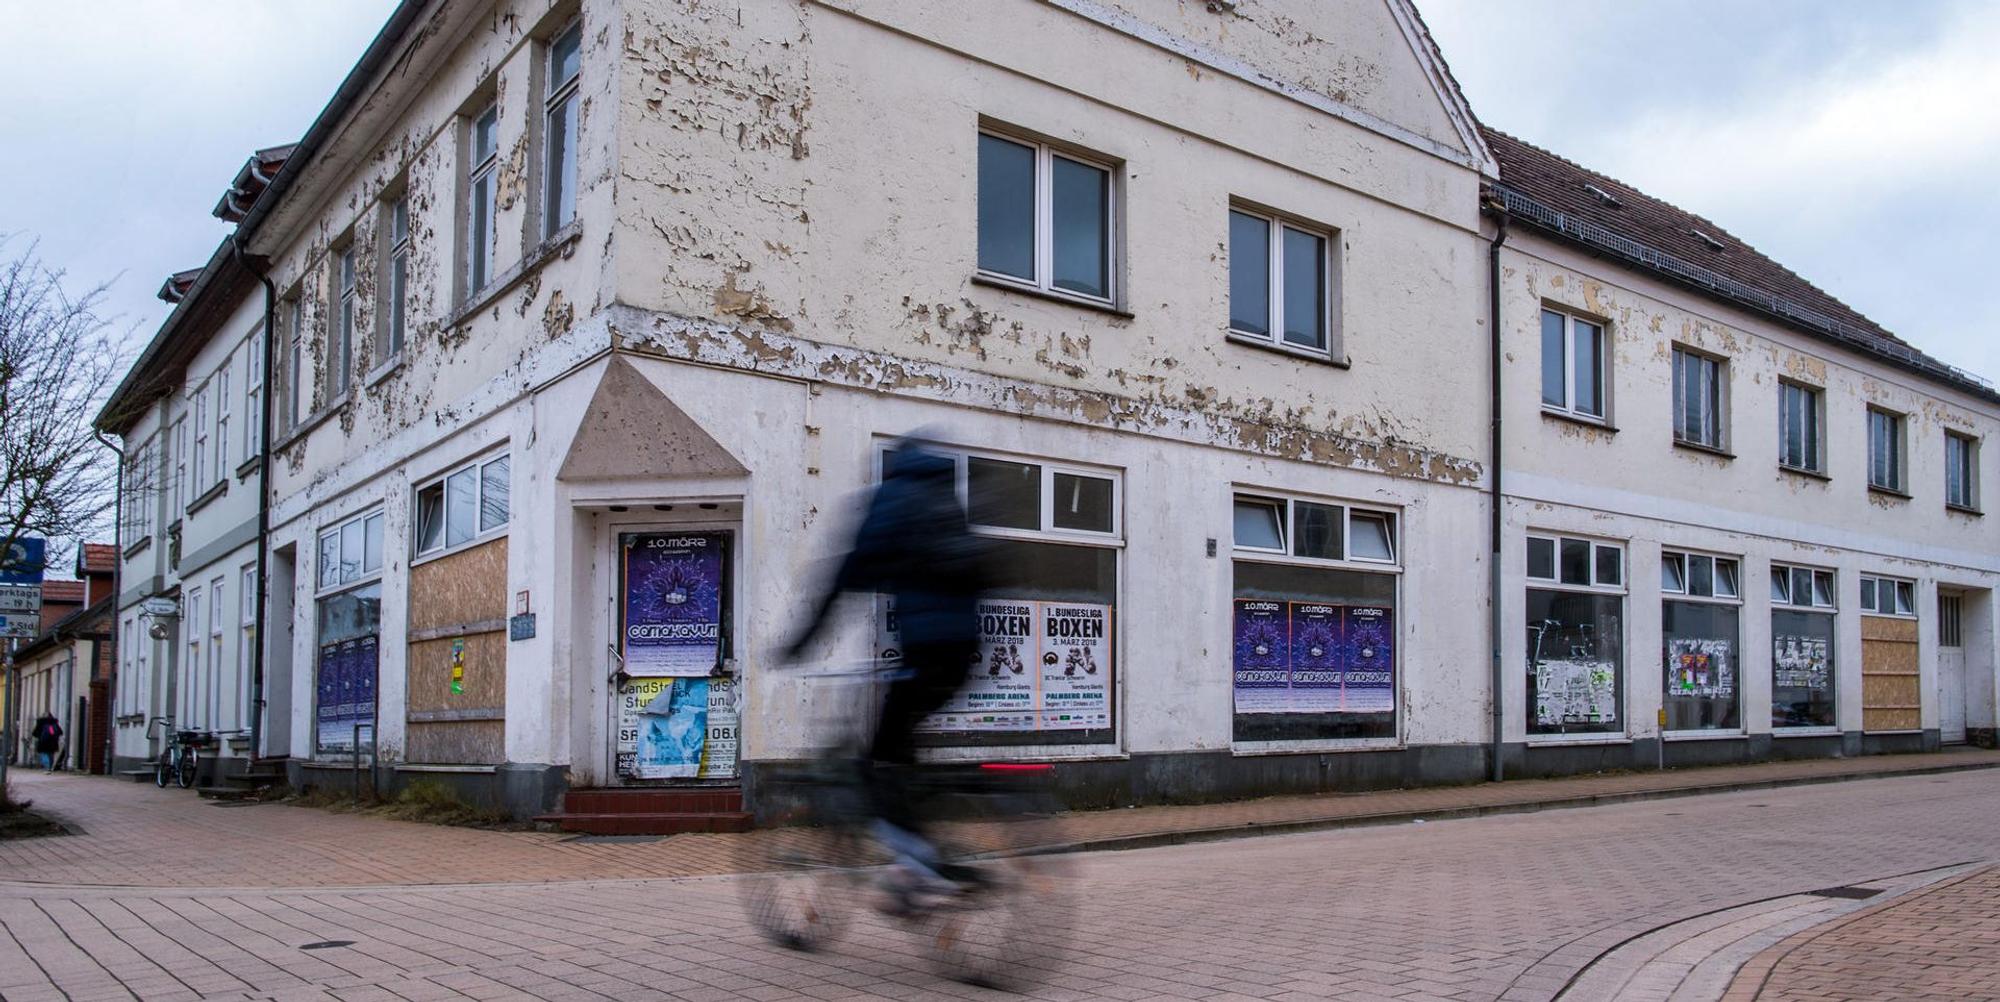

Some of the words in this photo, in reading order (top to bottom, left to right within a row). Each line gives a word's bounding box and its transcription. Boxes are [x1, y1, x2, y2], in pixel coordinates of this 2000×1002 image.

[979, 604, 1031, 616] BUNDESLIGA
[1055, 608, 1103, 619] BUNDESLIGA
[1046, 617, 1103, 638] BOXEN
[1007, 692, 1030, 700] ARENA
[1082, 692, 1103, 700] ARENA
